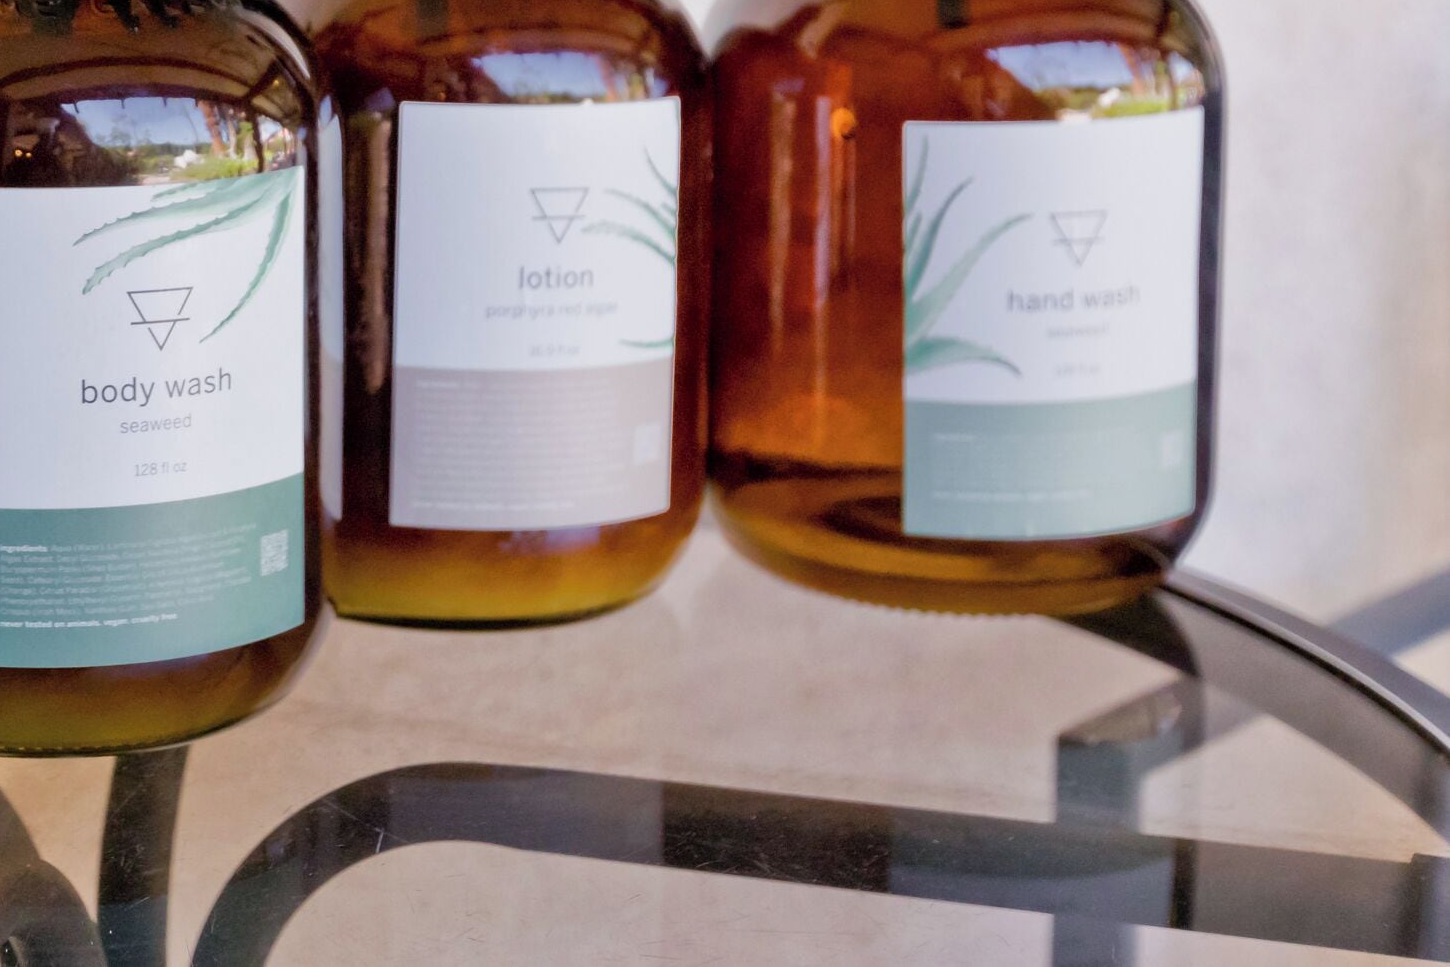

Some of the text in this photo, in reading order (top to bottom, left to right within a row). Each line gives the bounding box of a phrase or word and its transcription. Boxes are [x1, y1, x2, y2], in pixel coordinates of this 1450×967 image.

[518, 265, 594, 290] lotion
[1006, 284, 1141, 311] hand wash
[81, 367, 232, 407] body wash
[120, 413, 192, 434] seaweed
[134, 461, 187, 476] 128 fl oz
